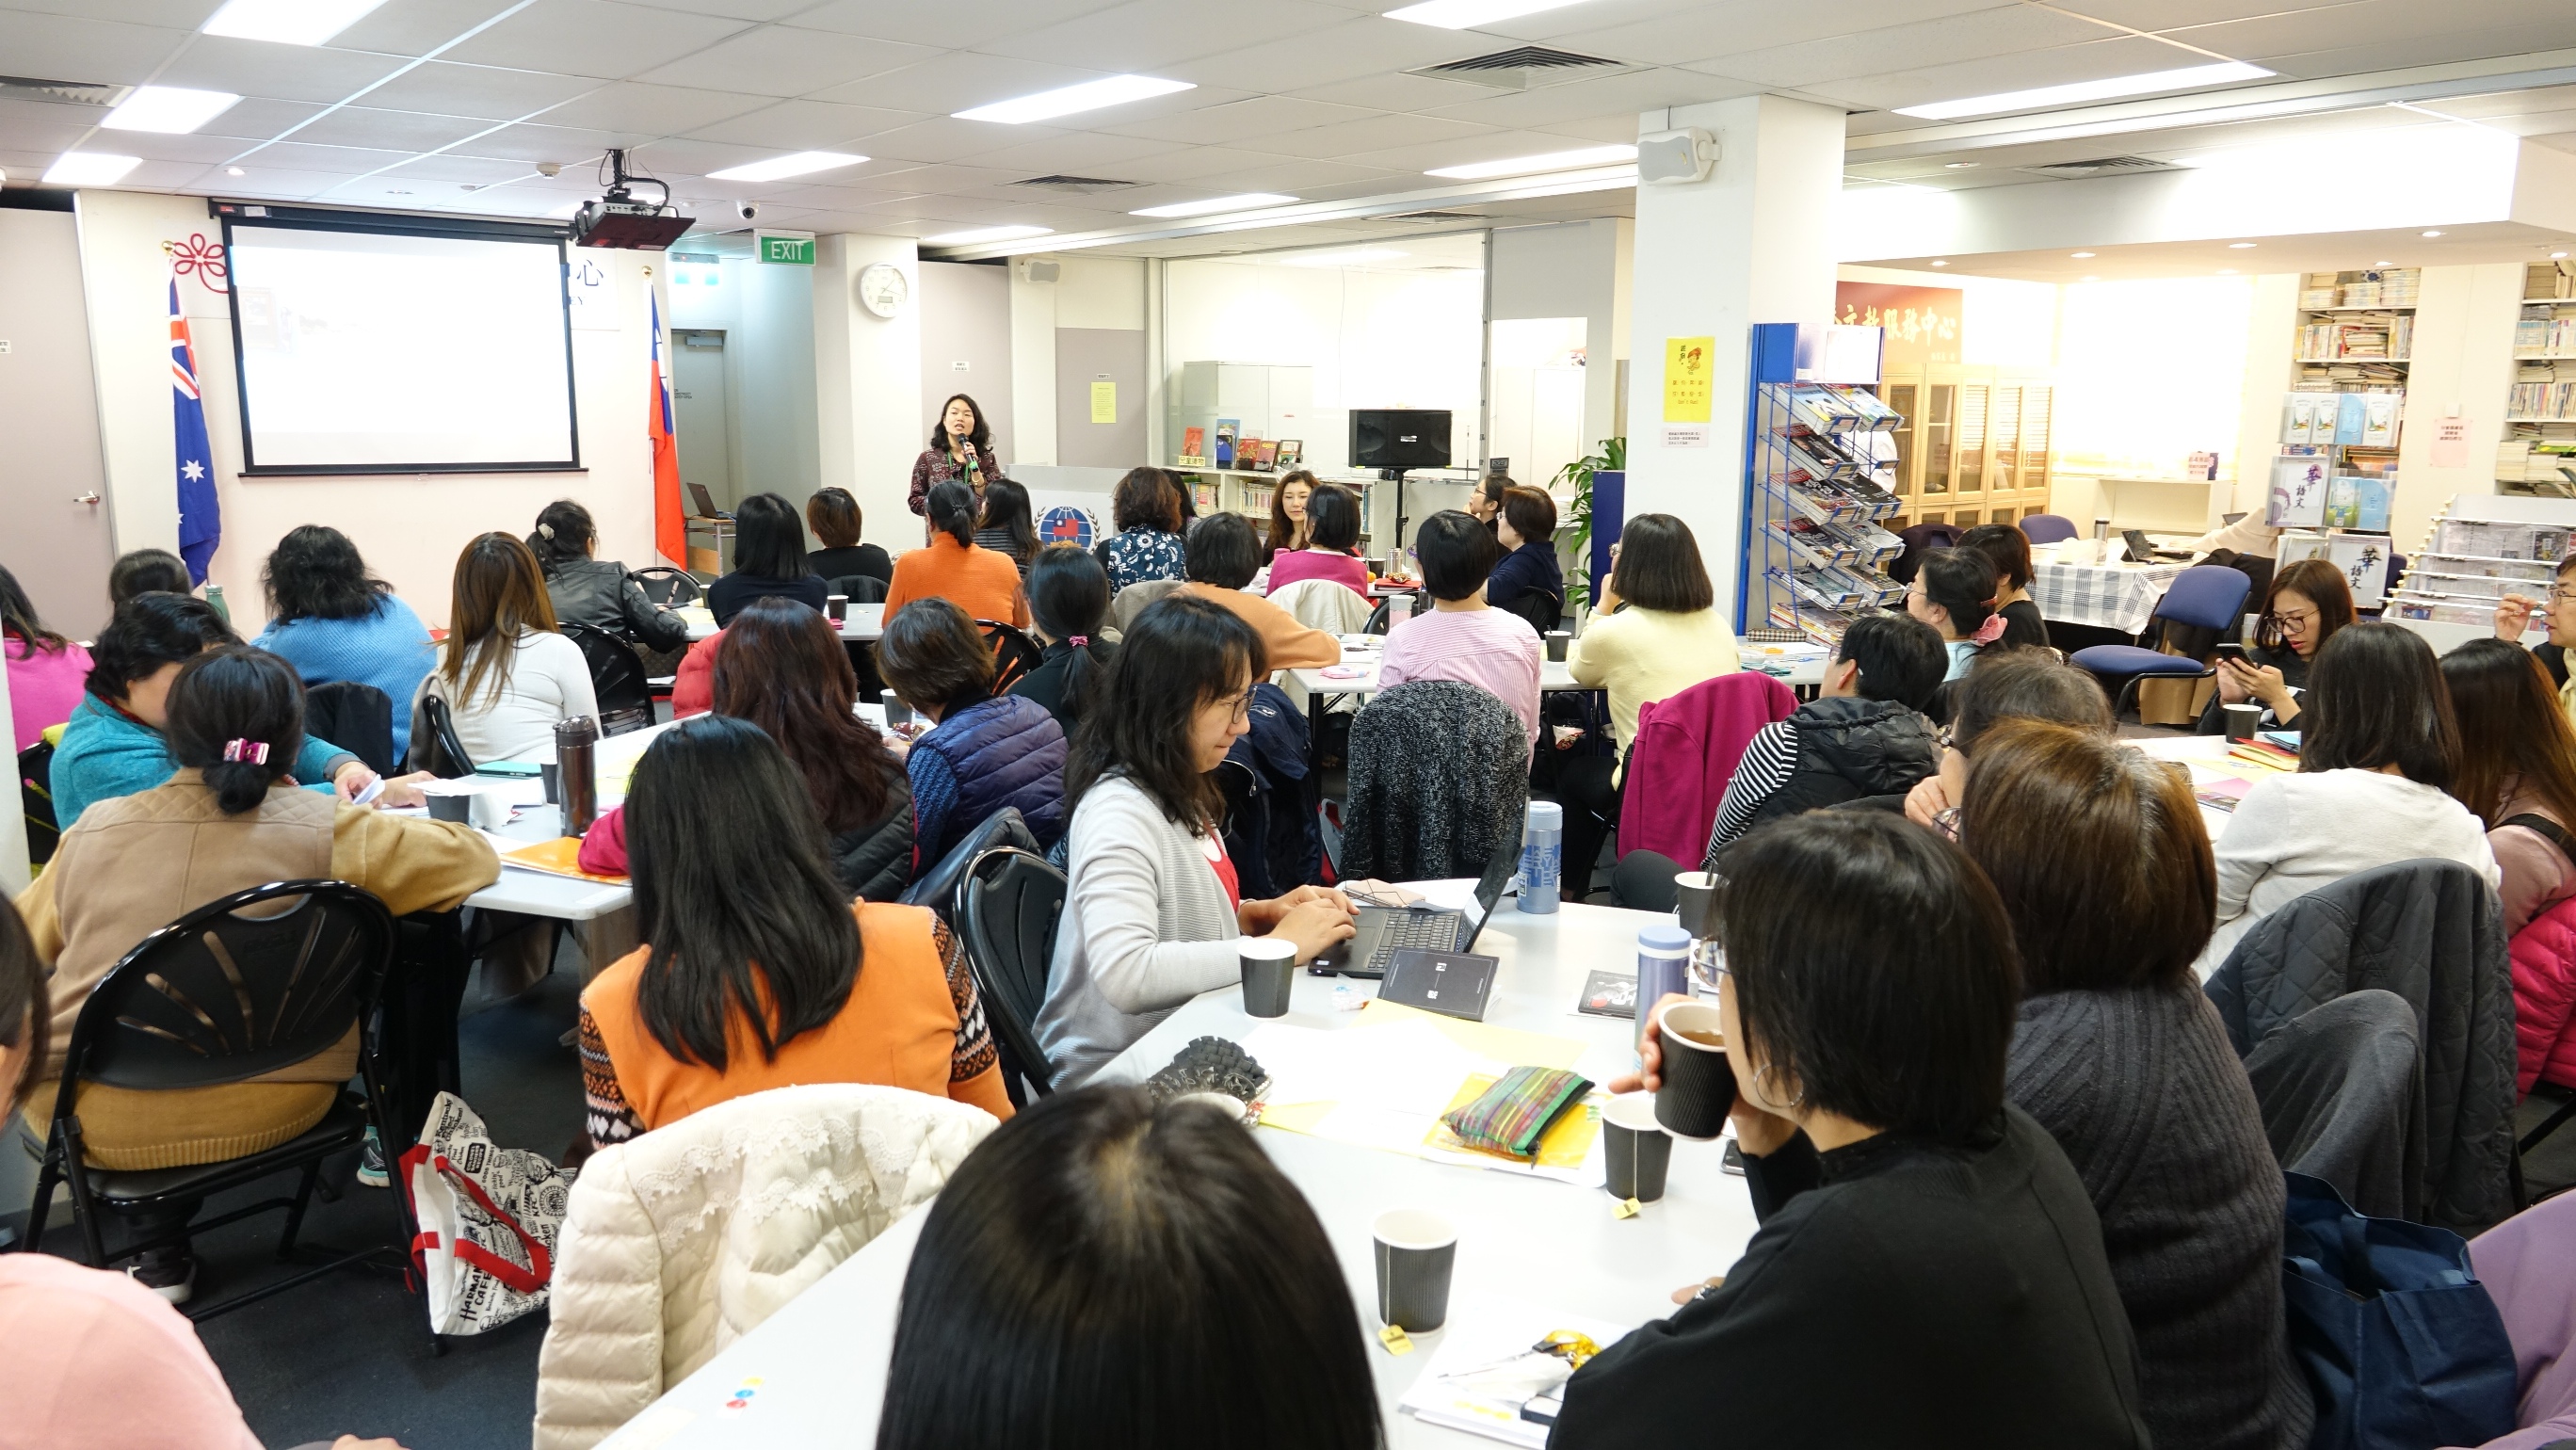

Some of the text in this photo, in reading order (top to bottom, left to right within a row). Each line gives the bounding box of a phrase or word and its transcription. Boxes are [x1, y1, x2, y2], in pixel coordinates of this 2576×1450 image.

[771, 241, 804, 260] EXIT
[576, 259, 604, 286] 心
[531, 1195, 539, 1217] KFC
[475, 1272, 492, 1306] CAFE
